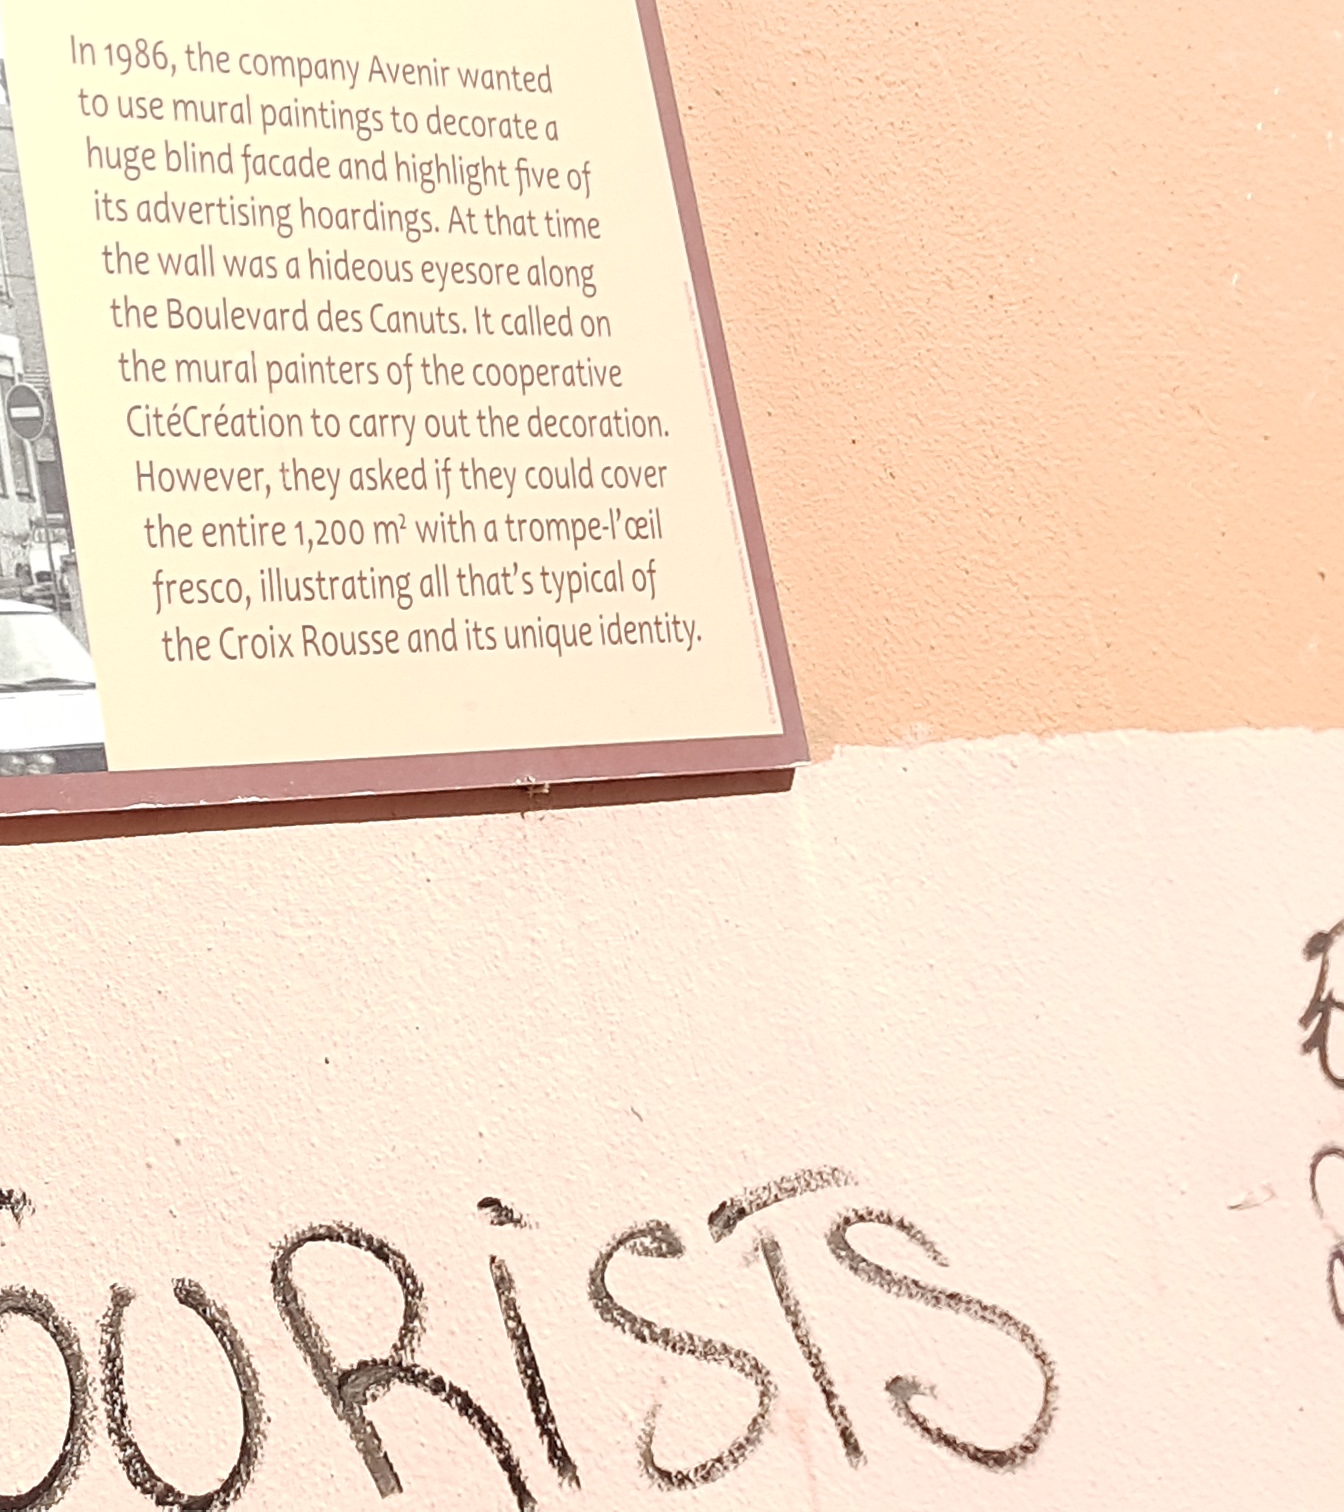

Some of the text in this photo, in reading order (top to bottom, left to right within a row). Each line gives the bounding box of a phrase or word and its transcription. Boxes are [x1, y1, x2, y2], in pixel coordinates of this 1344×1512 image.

[69, 33, 554, 95] In 1986, the company Avenir wanted
[77, 87, 560, 143] to use mural paintings to decorate a
[85, 134, 593, 201] huge blind facade and highlight five of
[93, 188, 602, 245] its advertising hoardings. At that time
[100, 239, 598, 300] the wall was a hideous eyesore along
[108, 293, 613, 339] the Boulevard des Canuts. It called on
[116, 347, 624, 397] the mural painters of the cooperative
[125, 401, 670, 448] CitéCréation to carry out the decoration.
[134, 455, 669, 502] However, they asked if they could cover
[142, 511, 194, 550] the
[200, 512, 288, 549] entire
[293, 518, 366, 555] 1,200
[413, 508, 478, 545] with
[482, 518, 500, 544] a
[150, 567, 253, 616] fresco,
[258, 565, 415, 612] illustrating
[418, 562, 451, 599] all
[538, 558, 626, 605] typical
[630, 557, 658, 602] of
[160, 624, 212, 664] the
[217, 623, 296, 662] Croix
[300, 623, 401, 658] Rousse
[406, 616, 460, 655] and
[463, 617, 499, 652] its
[502, 614, 594, 659] unique
[597, 610, 703, 653] identity.
